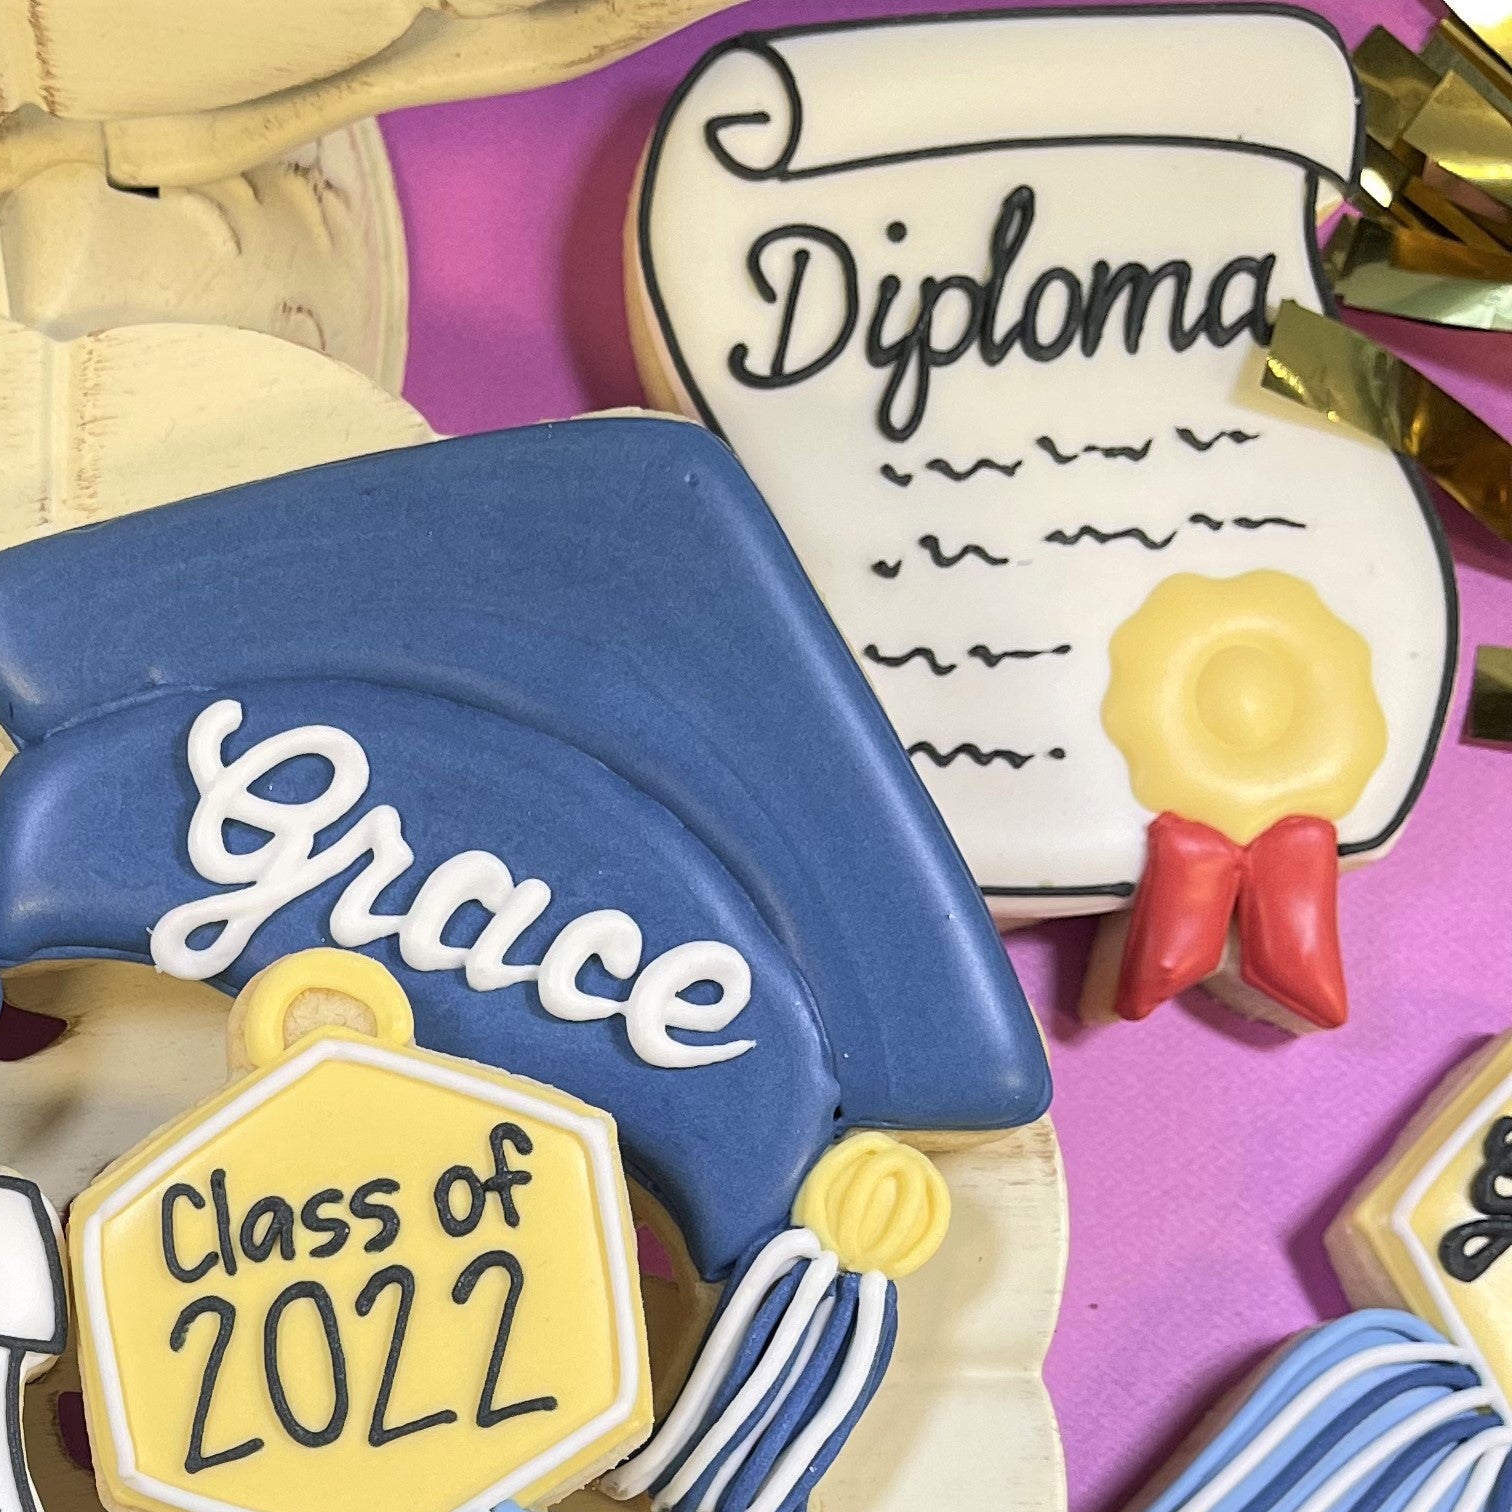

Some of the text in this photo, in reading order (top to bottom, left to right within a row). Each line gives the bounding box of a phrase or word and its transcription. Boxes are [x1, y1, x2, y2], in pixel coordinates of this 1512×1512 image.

[728, 185, 1277, 442] Diploma
[148, 699, 756, 1068] Grace
[161, 1121, 533, 1284] Class of
[169, 1249, 558, 1475] 2022
